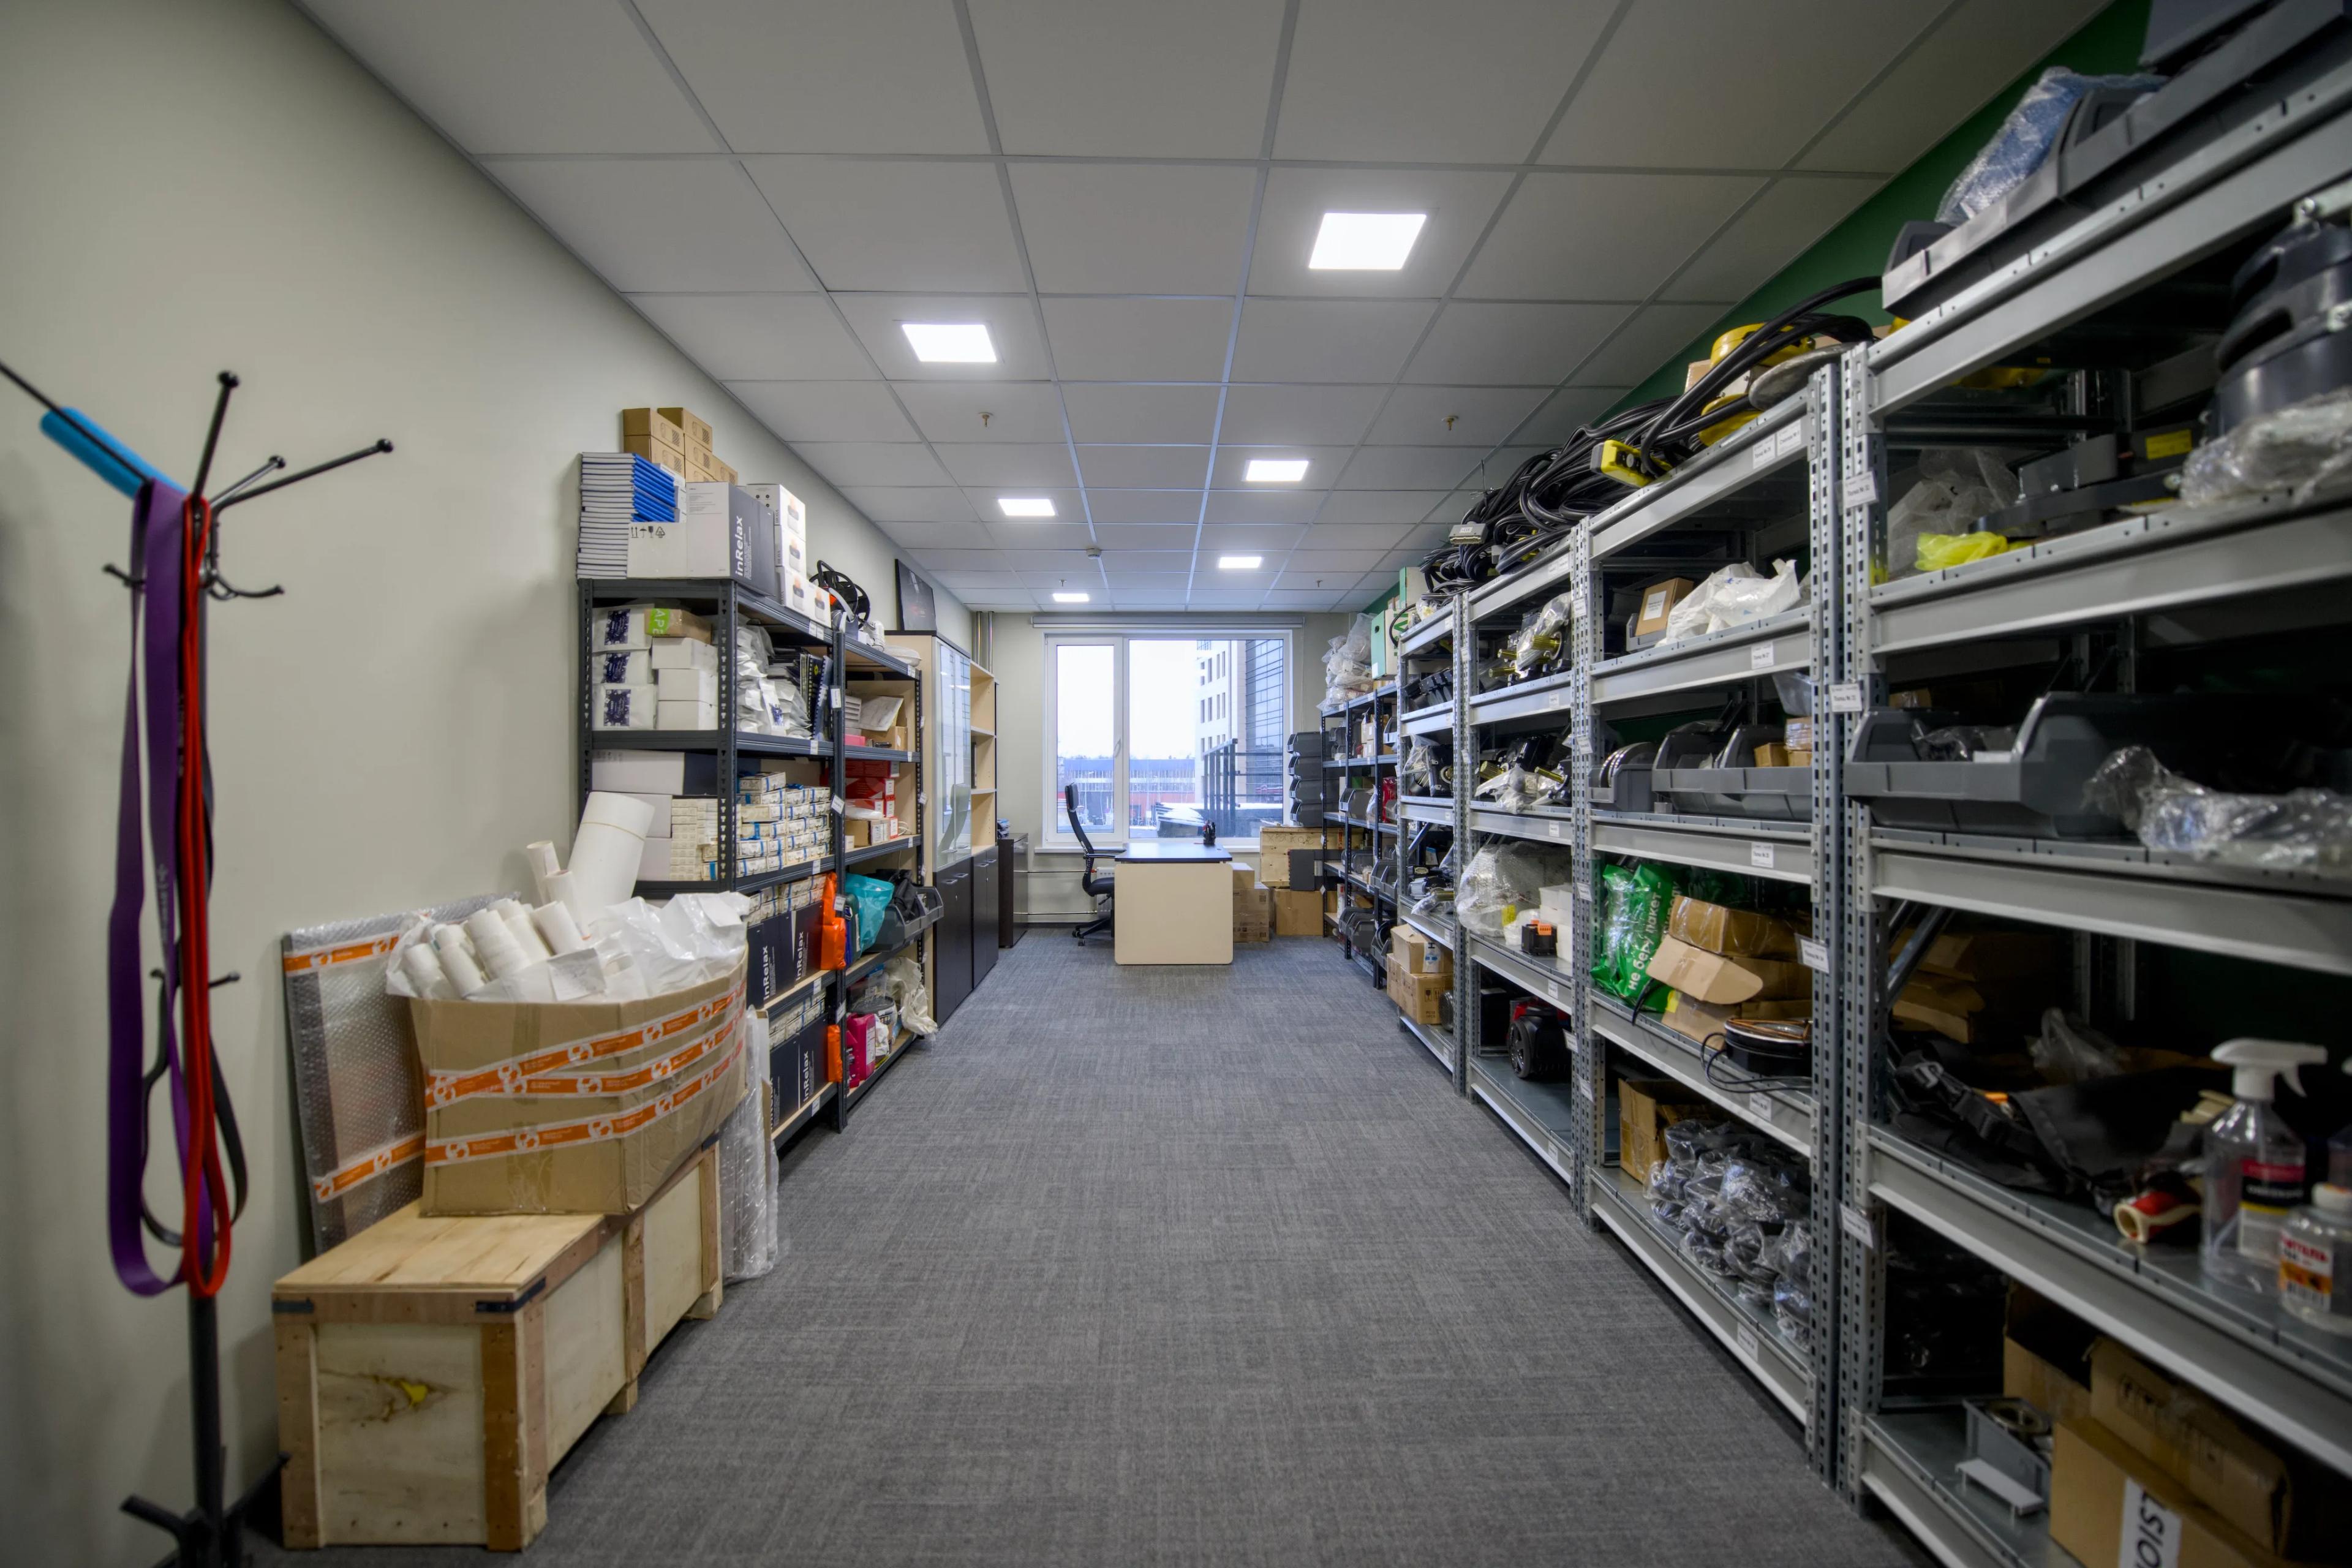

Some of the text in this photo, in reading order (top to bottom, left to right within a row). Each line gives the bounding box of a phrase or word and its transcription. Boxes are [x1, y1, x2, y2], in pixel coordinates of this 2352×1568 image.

[734, 515, 743, 576] inRelax
[795, 931, 804, 981] inRelax
[1628, 971, 1642, 990] не
[1645, 892, 1662, 934] пакет
